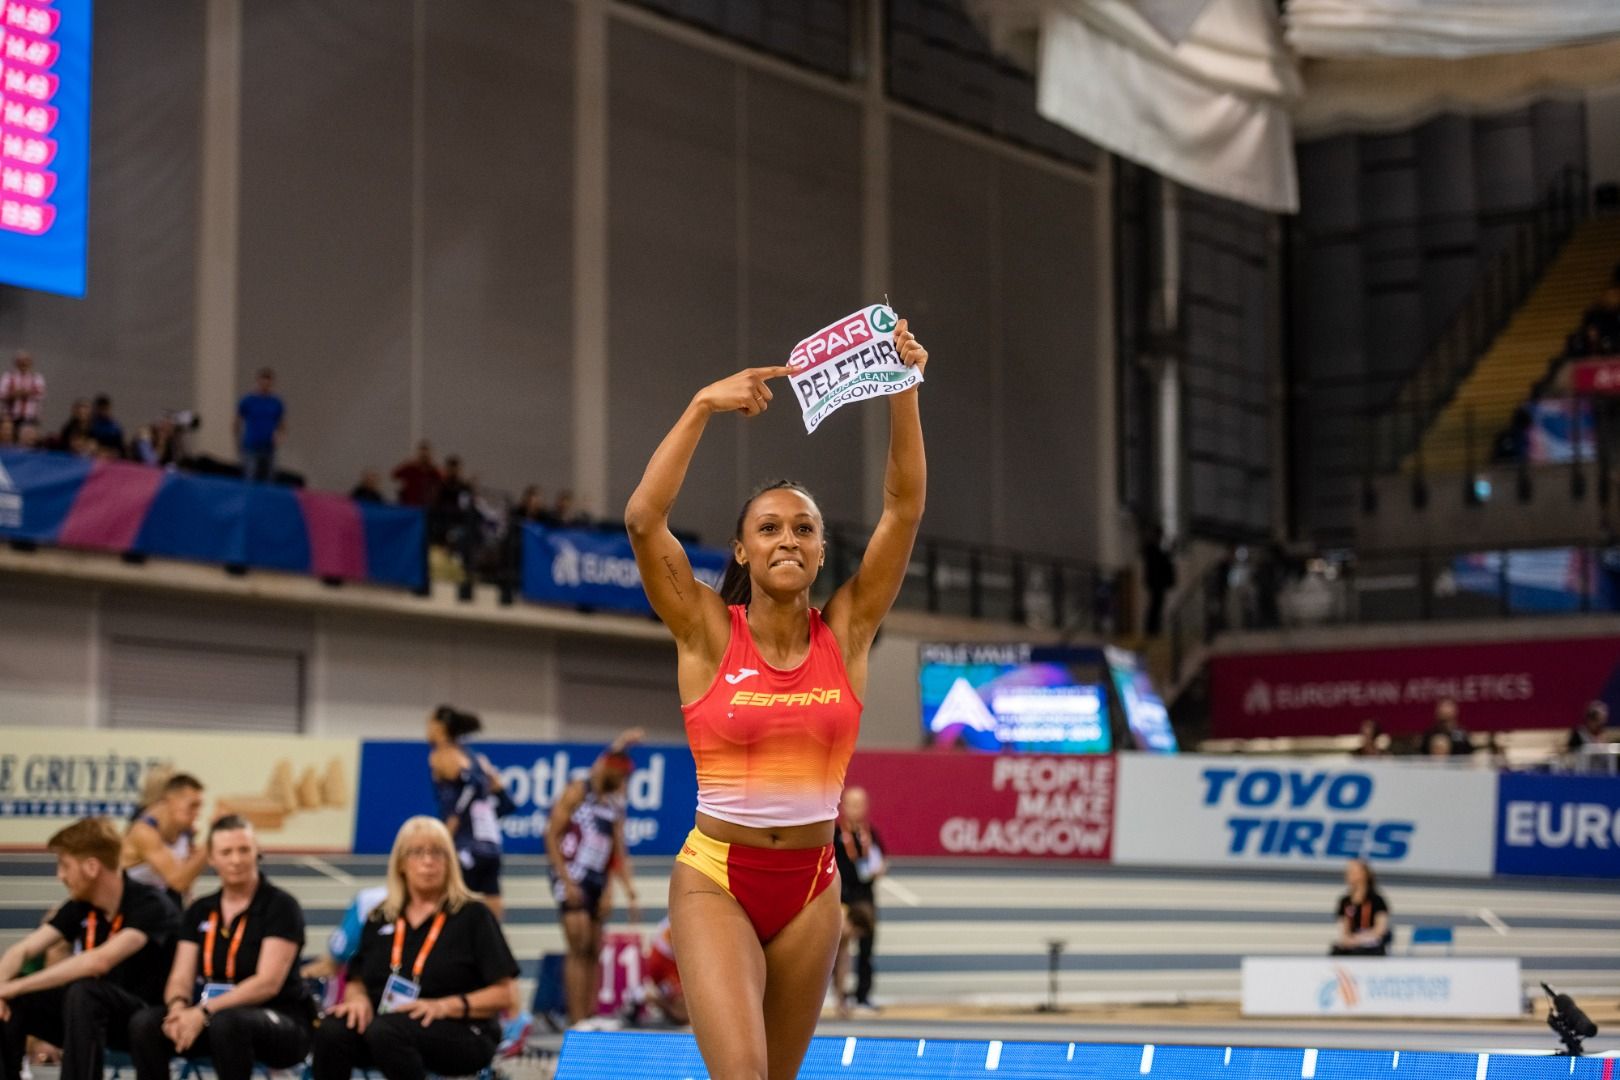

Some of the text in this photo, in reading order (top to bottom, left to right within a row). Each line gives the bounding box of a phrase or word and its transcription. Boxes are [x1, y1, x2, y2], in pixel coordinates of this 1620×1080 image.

[789, 318, 870, 369] SPAR
[797, 340, 905, 409] PELETEIR
[810, 375, 916, 427] GLASGOW 2019
[730, 688, 842, 707] ESPAÑA
[24, 749, 166, 793] GRUYÈR
[993, 757, 1113, 791] PEOPLE
[1202, 769, 1373, 810] TOYO
[1017, 793, 1112, 820] MAKE
[1505, 802, 1620, 849] EUR
[940, 817, 1109, 854] GLASGOW
[1227, 818, 1415, 860] TIRES
